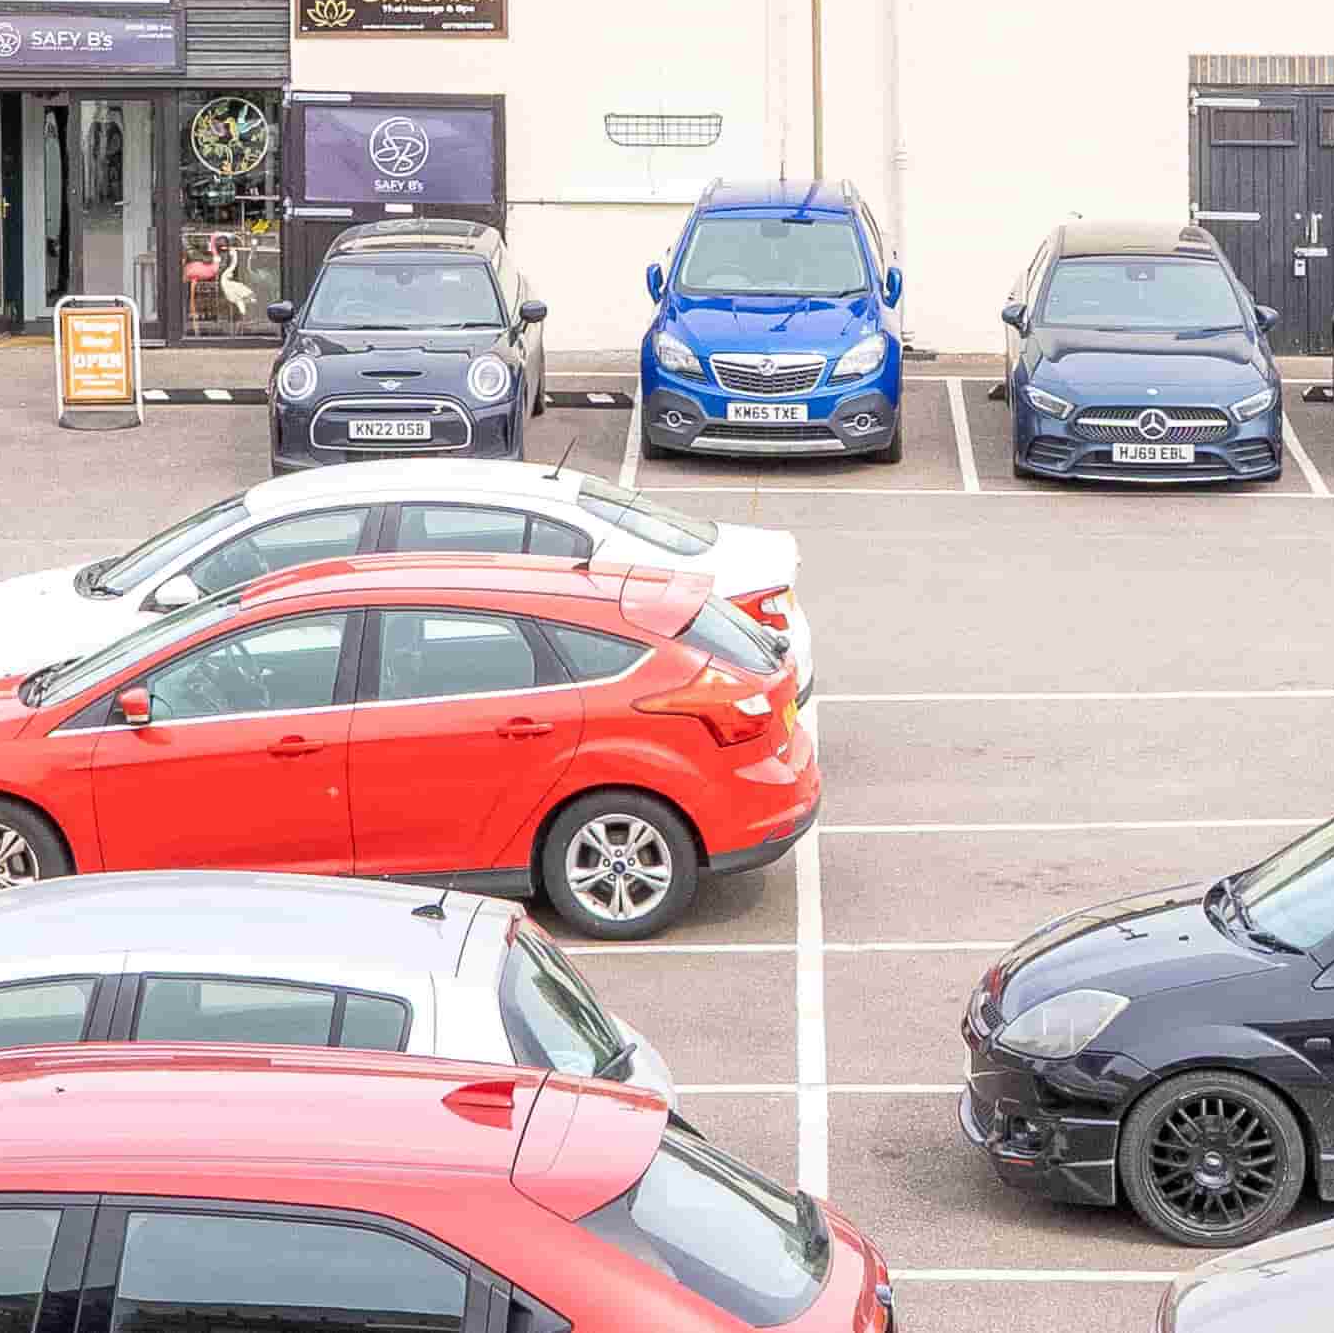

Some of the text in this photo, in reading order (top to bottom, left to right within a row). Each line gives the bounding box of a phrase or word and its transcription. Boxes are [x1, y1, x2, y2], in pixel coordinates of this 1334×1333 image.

[31, 30, 114, 47] SAFY B's
[374, 179, 405, 190] SAFY
[773, 406, 798, 419] TXE
[355, 422, 392, 436] KN22
[1119, 447, 1156, 459] HJ69
